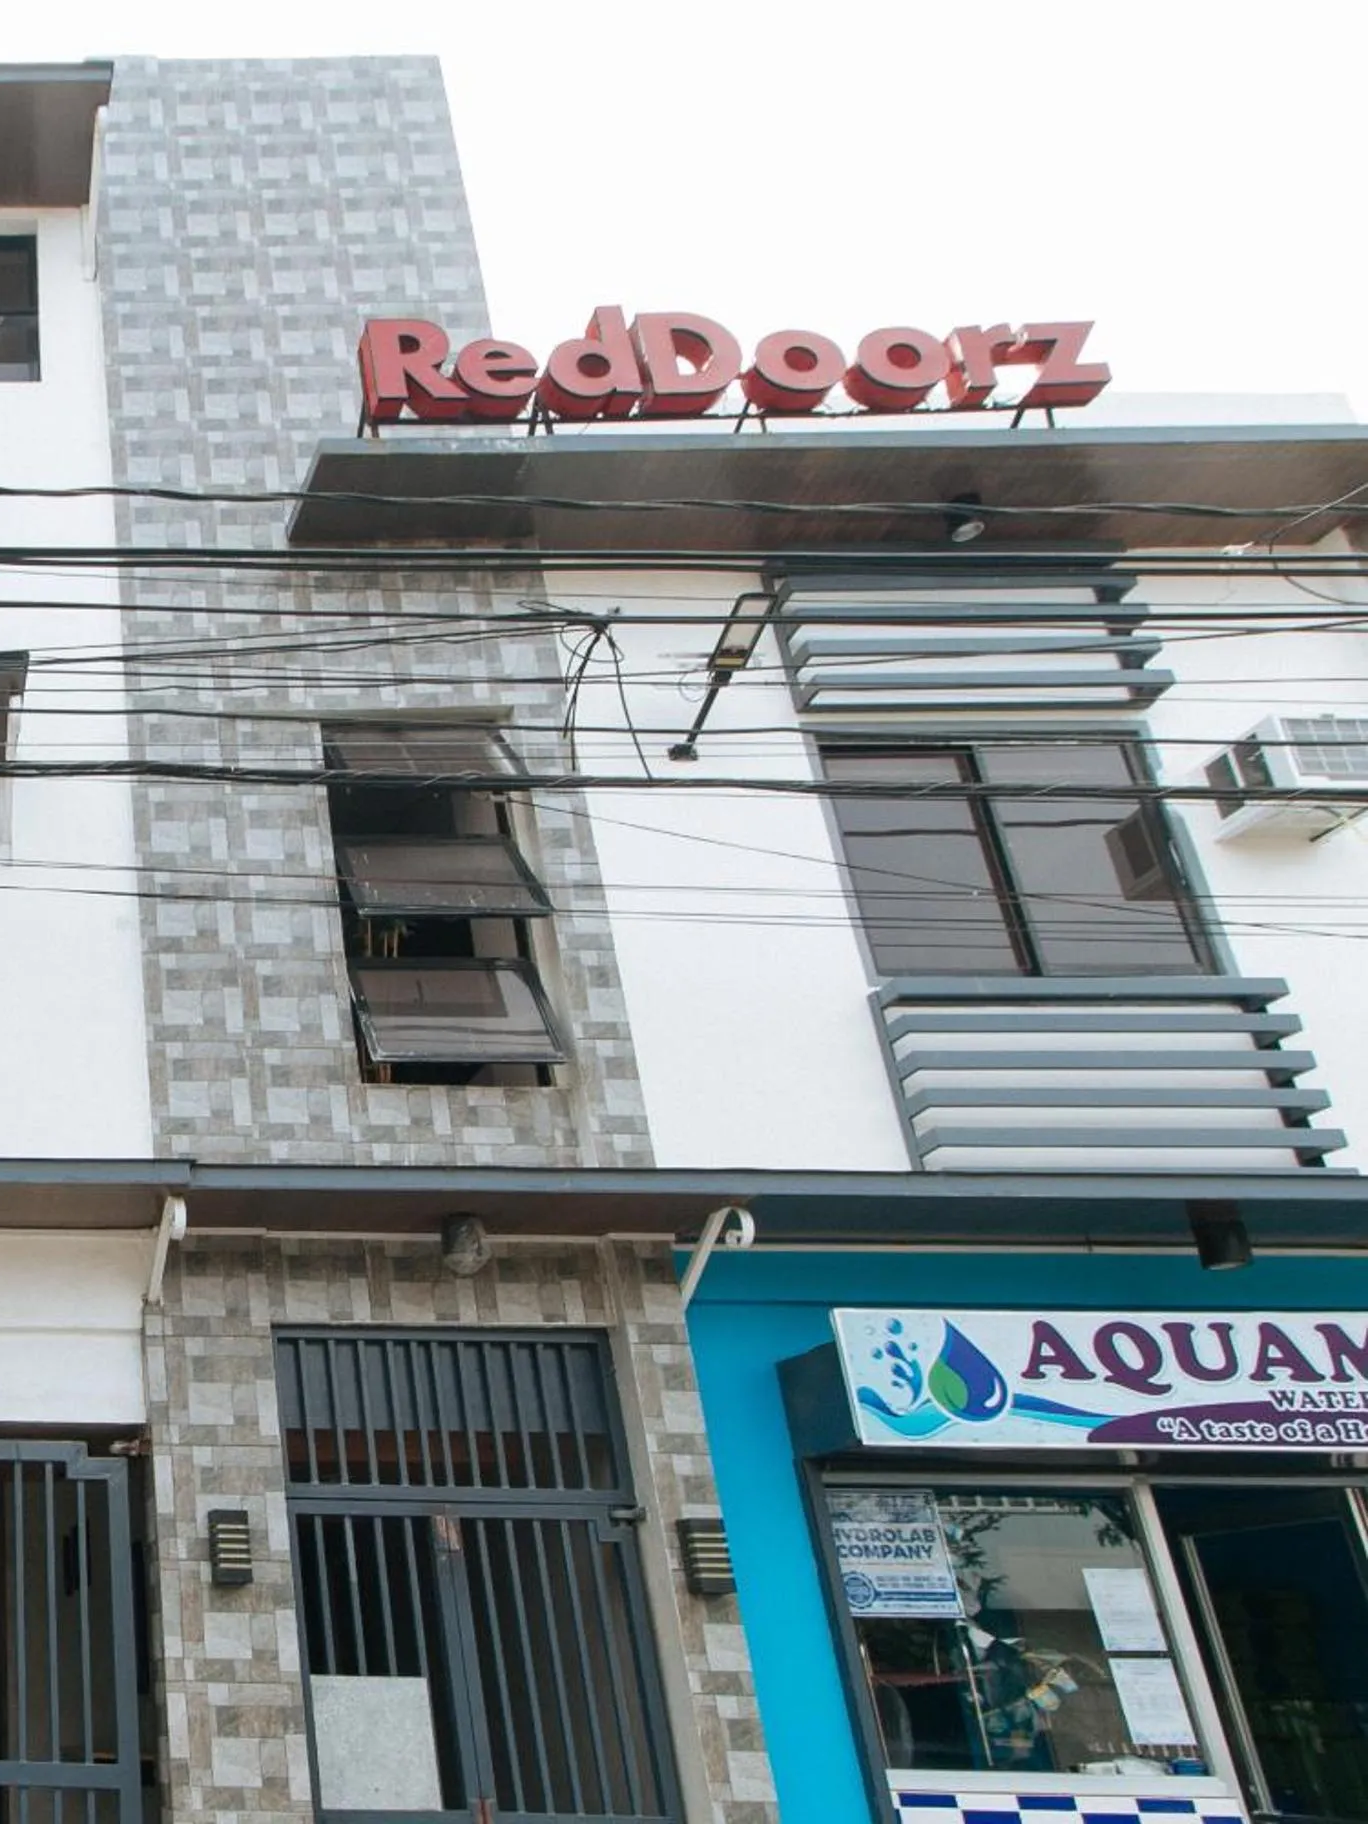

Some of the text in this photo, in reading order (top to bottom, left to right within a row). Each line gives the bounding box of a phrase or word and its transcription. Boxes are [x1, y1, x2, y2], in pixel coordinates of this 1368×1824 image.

[358, 305, 1112, 420] RedDoorz
[1201, 1419, 1277, 1440] taste
[1280, 1419, 1313, 1441] of
[1316, 1423, 1337, 1441] a
[1340, 1419, 1368, 1441] H
[833, 1528, 937, 1543] HYDROLAB
[837, 1545, 933, 1559] COMPANY
